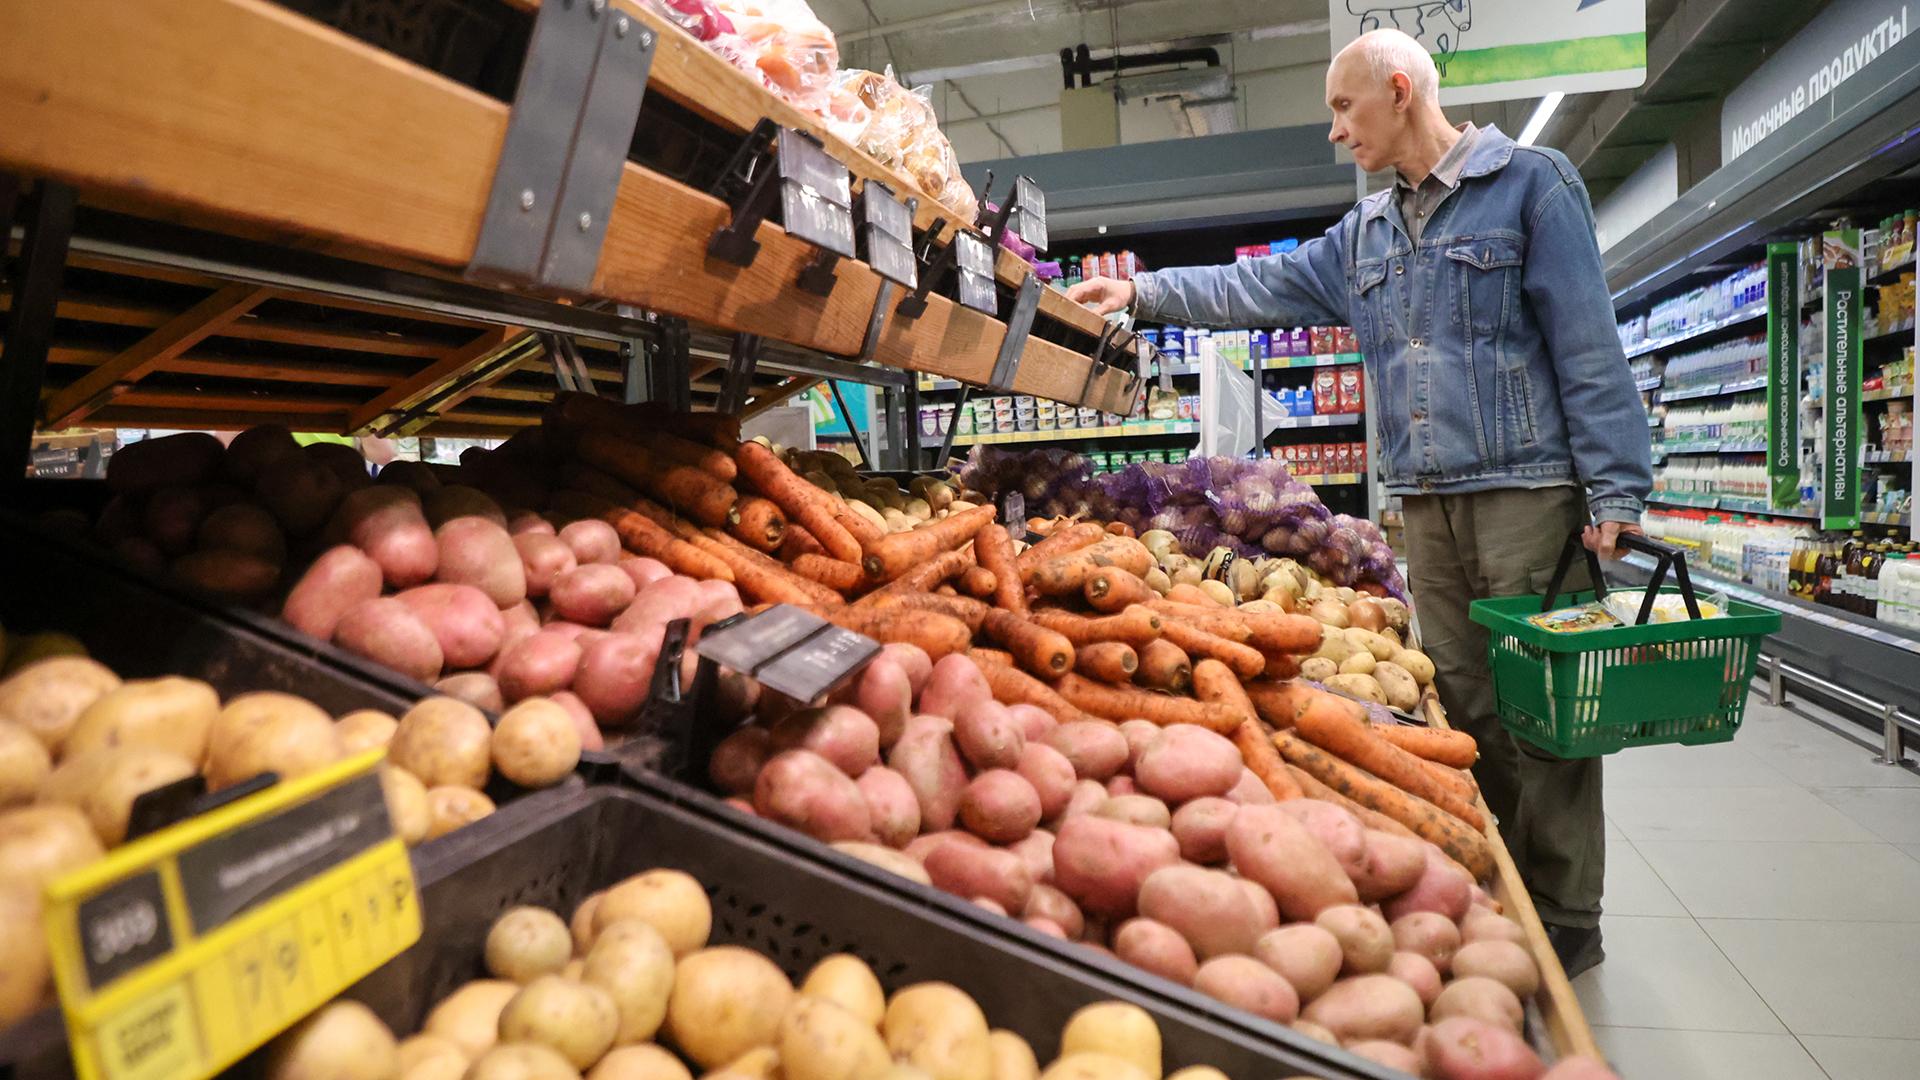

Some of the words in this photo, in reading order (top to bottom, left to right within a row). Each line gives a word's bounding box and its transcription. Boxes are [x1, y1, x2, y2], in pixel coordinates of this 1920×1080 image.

[1731, 86, 1806, 159] Молочные
[1808, 6, 1907, 105] продукты
[1779, 261, 1790, 316] продукция
[1779, 317, 1790, 385] безлактозная
[1835, 290, 1852, 394] Растительные
[1778, 395, 1789, 467] Органическая
[1832, 396, 1849, 500] альтернативы
